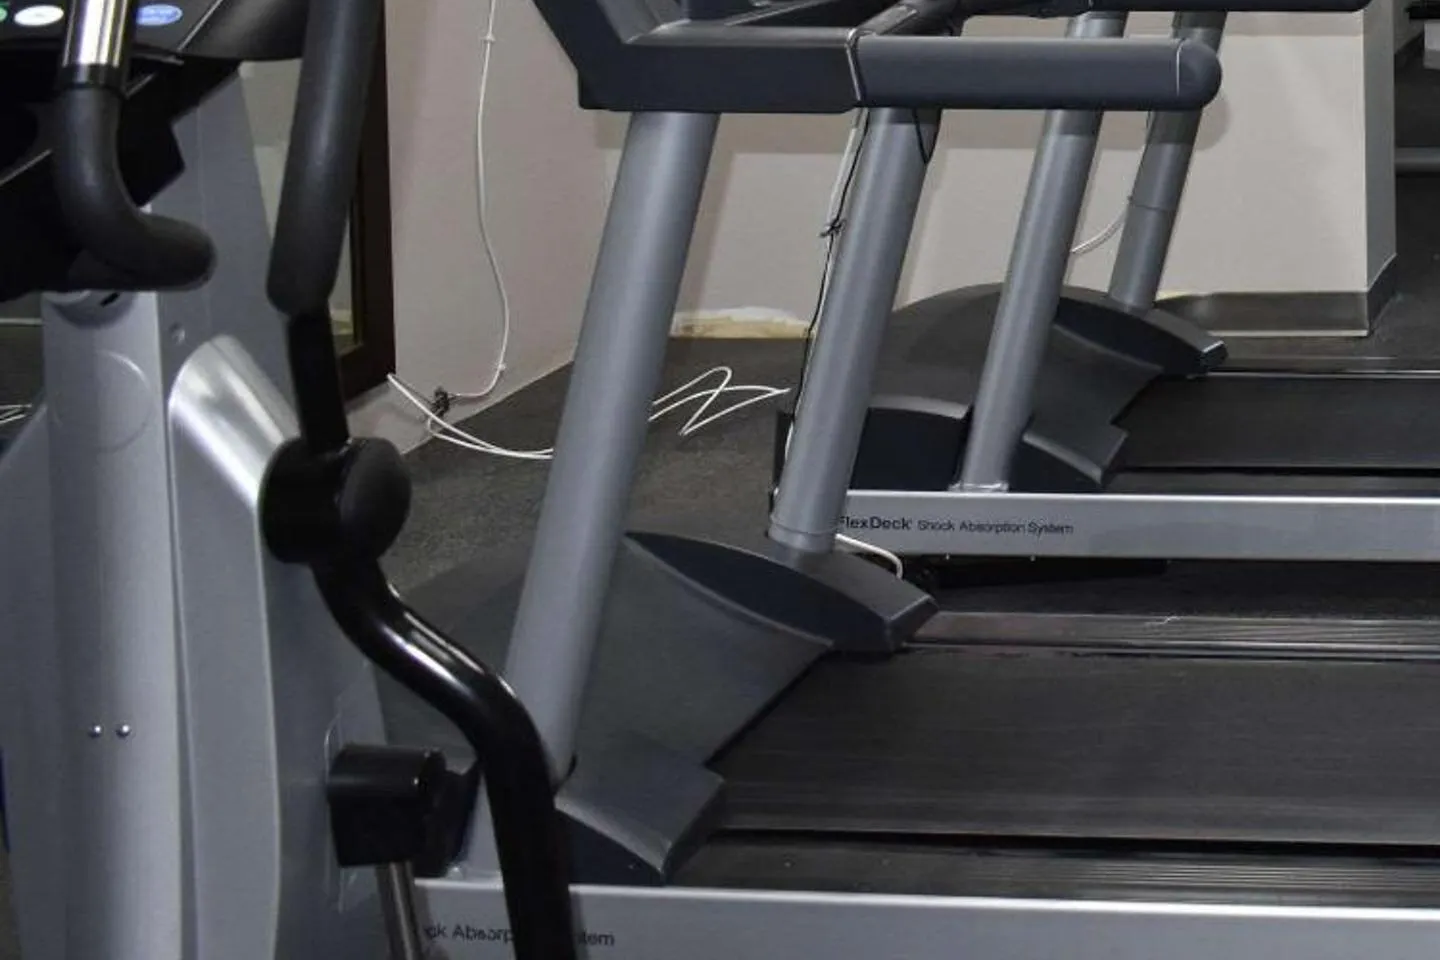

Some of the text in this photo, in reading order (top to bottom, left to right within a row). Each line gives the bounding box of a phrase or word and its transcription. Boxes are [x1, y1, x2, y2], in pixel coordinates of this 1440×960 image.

[917, 518, 955, 532] Shock
[959, 520, 1025, 535] Absorption
[1027, 521, 1074, 538] System
[452, 924, 514, 943] Absorp
